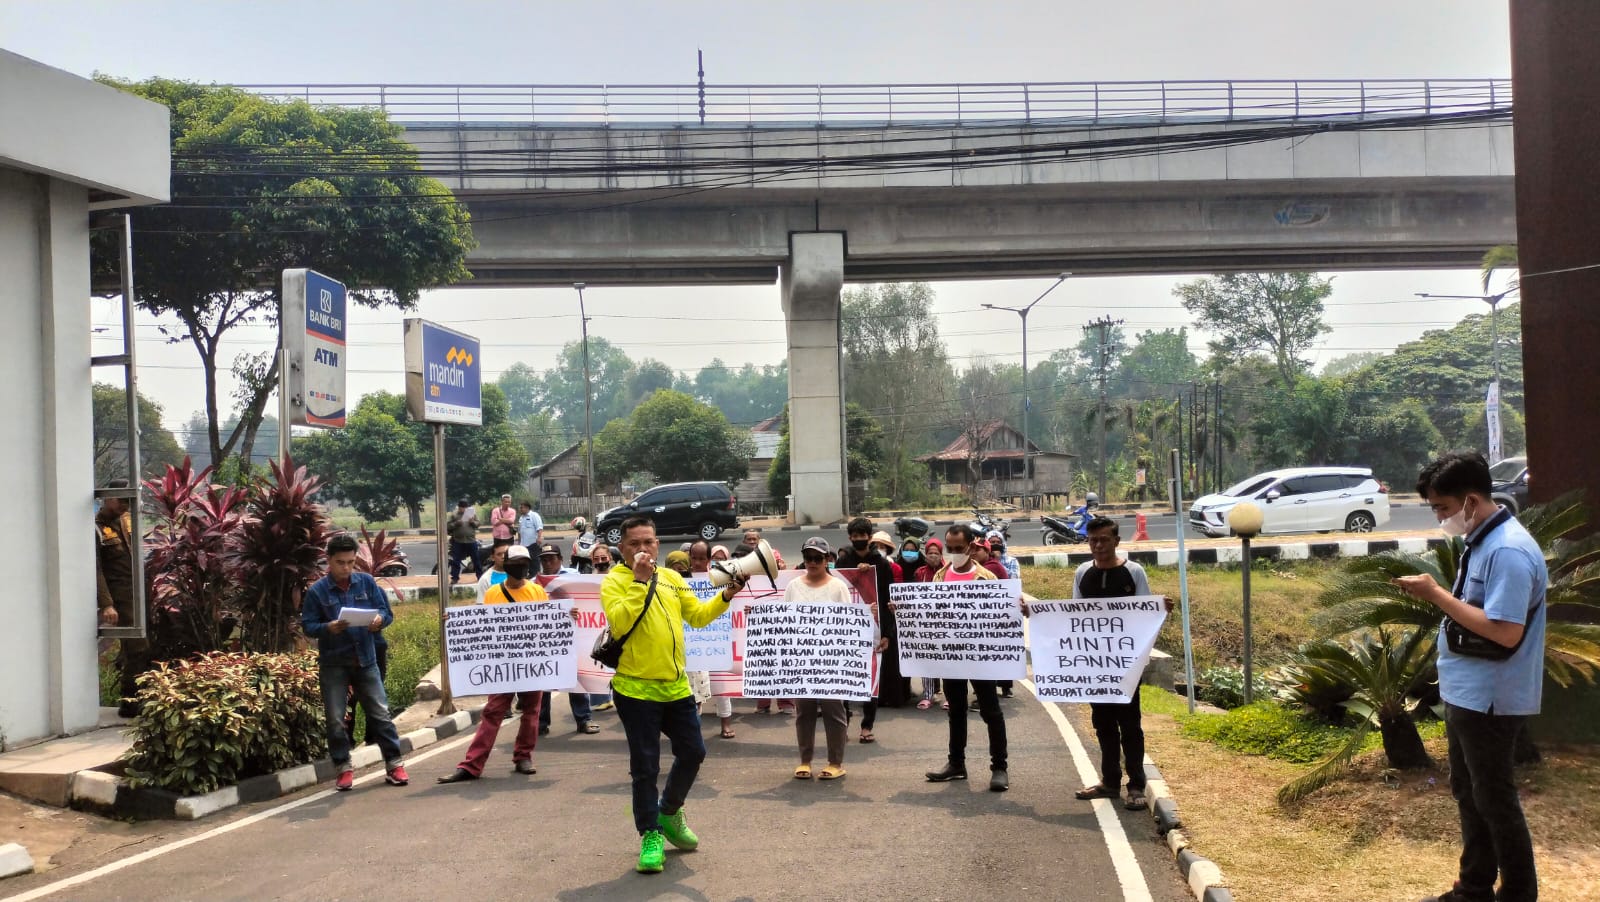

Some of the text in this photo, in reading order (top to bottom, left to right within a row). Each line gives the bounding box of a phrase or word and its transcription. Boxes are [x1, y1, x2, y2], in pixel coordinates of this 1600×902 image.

[310, 309, 342, 332] BANK BRI
[314, 348, 338, 368] ATM
[430, 384, 440, 397] atm
[934, 584, 961, 592] KEJATI
[890, 593, 918, 602] UNTUK
[494, 605, 522, 614] KEJATI
[525, 602, 563, 612] SUMSEL
[796, 605, 825, 614] KEJATI
[828, 606, 870, 616] SUMSEL
[979, 602, 1016, 610] UNTUK
[1031, 601, 1160, 614] USUT TUNTAS INDIKASI
[478, 616, 531, 624] MEMBENTUK
[552, 612, 569, 620] UTK
[926, 612, 968, 620] DIPERIKSA
[970, 612, 1011, 620] KARENA
[748, 616, 870, 628] MELAKUKAN PENYELIDIKAN
[918, 621, 977, 629] MEMBERIKAN
[1070, 616, 1124, 633] PAPA
[448, 621, 572, 637] MELAKUKAN PENYELIDIKAN DAN
[746, 628, 762, 638] DAN
[822, 628, 860, 637] OKNUM
[496, 632, 537, 642] TERHADAP
[920, 632, 951, 640] KEPSEK
[470, 642, 536, 651] BERTENTANGAN
[539, 640, 573, 648] DENGAN
[746, 638, 776, 648] KAJARI
[777, 638, 792, 646] OKI
[796, 638, 834, 647] KARENA
[942, 642, 976, 652] BANNER
[1059, 636, 1134, 652] MINTA
[746, 648, 776, 658] TANGAN
[780, 648, 814, 656] DENGAN
[900, 652, 912, 660] AN
[744, 658, 778, 668] UNDANG
[810, 658, 839, 666] TAHUN
[843, 660, 867, 670] 2001
[1056, 655, 1138, 668] BANNE
[469, 661, 558, 686] GRATIFIKASI
[744, 670, 778, 678] TENTANG
[1036, 674, 1046, 684] DI
[744, 678, 772, 687] PIDANA
[773, 676, 804, 686] KORUPSI
[744, 688, 780, 696] DIMAKSUD
